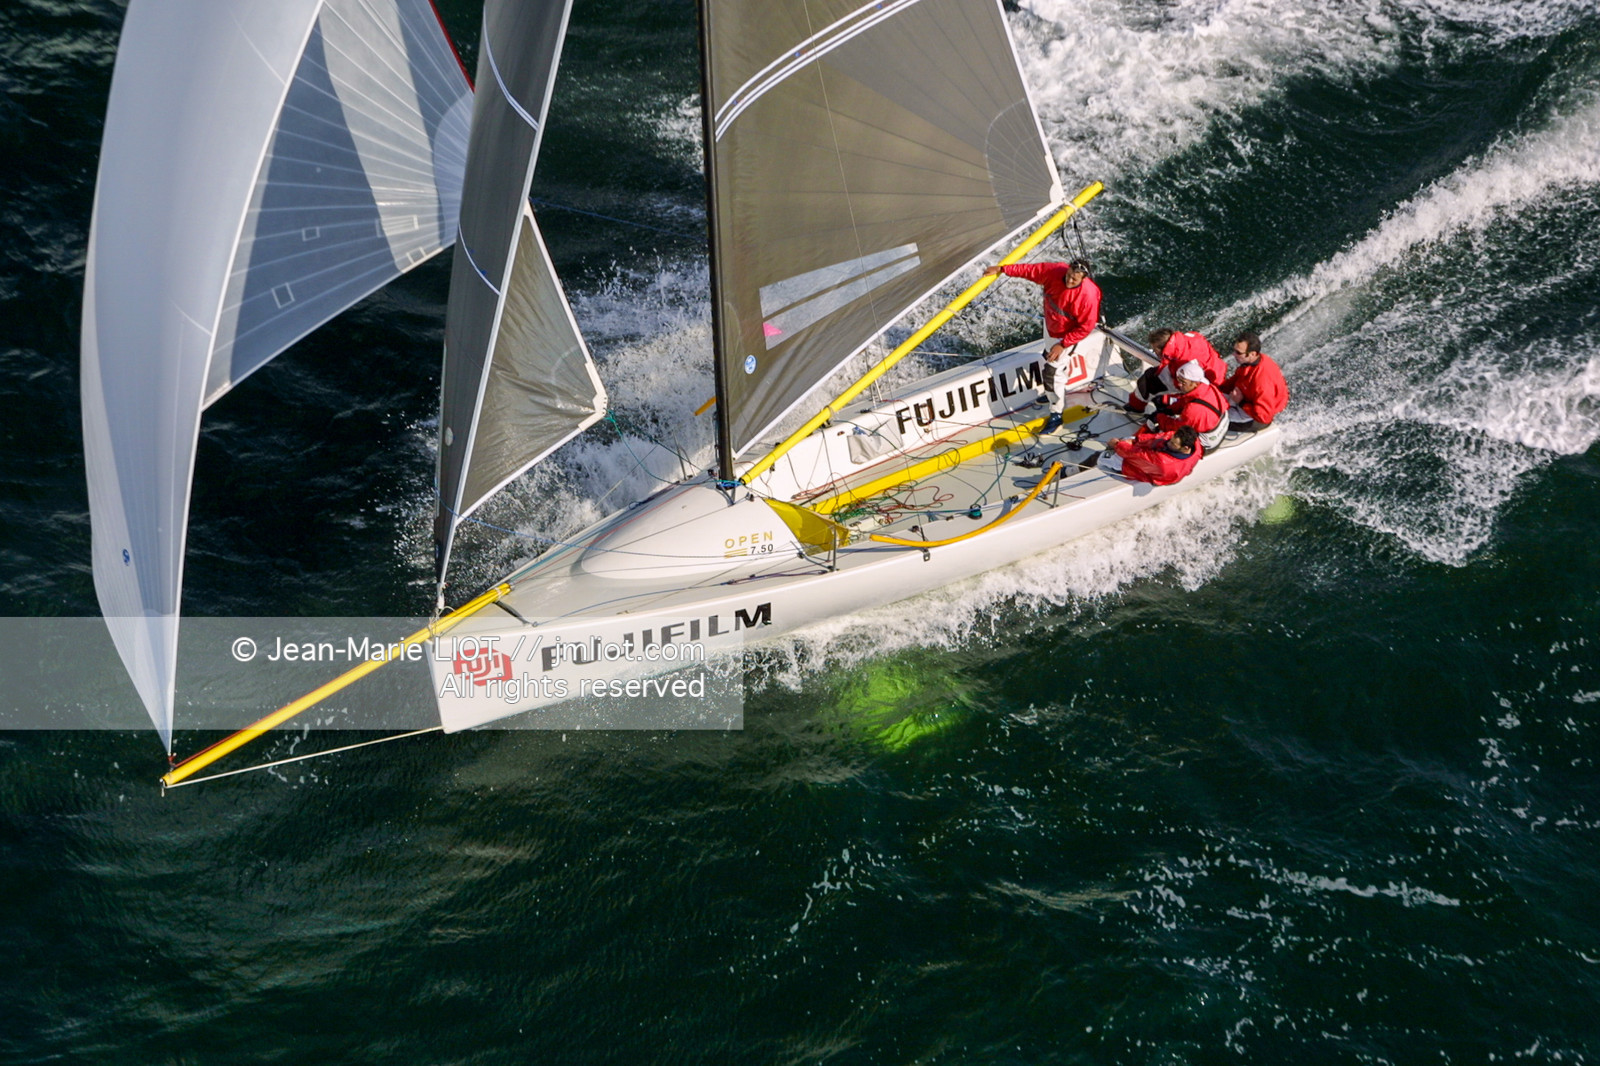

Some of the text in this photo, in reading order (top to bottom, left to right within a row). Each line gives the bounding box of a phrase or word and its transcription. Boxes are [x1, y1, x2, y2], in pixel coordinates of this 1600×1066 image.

[895, 360, 1043, 434] FUJIFILM
[724, 530, 774, 549] OPEN
[750, 543, 774, 555] 7.50
[541, 602, 772, 672] FUJIFILM
